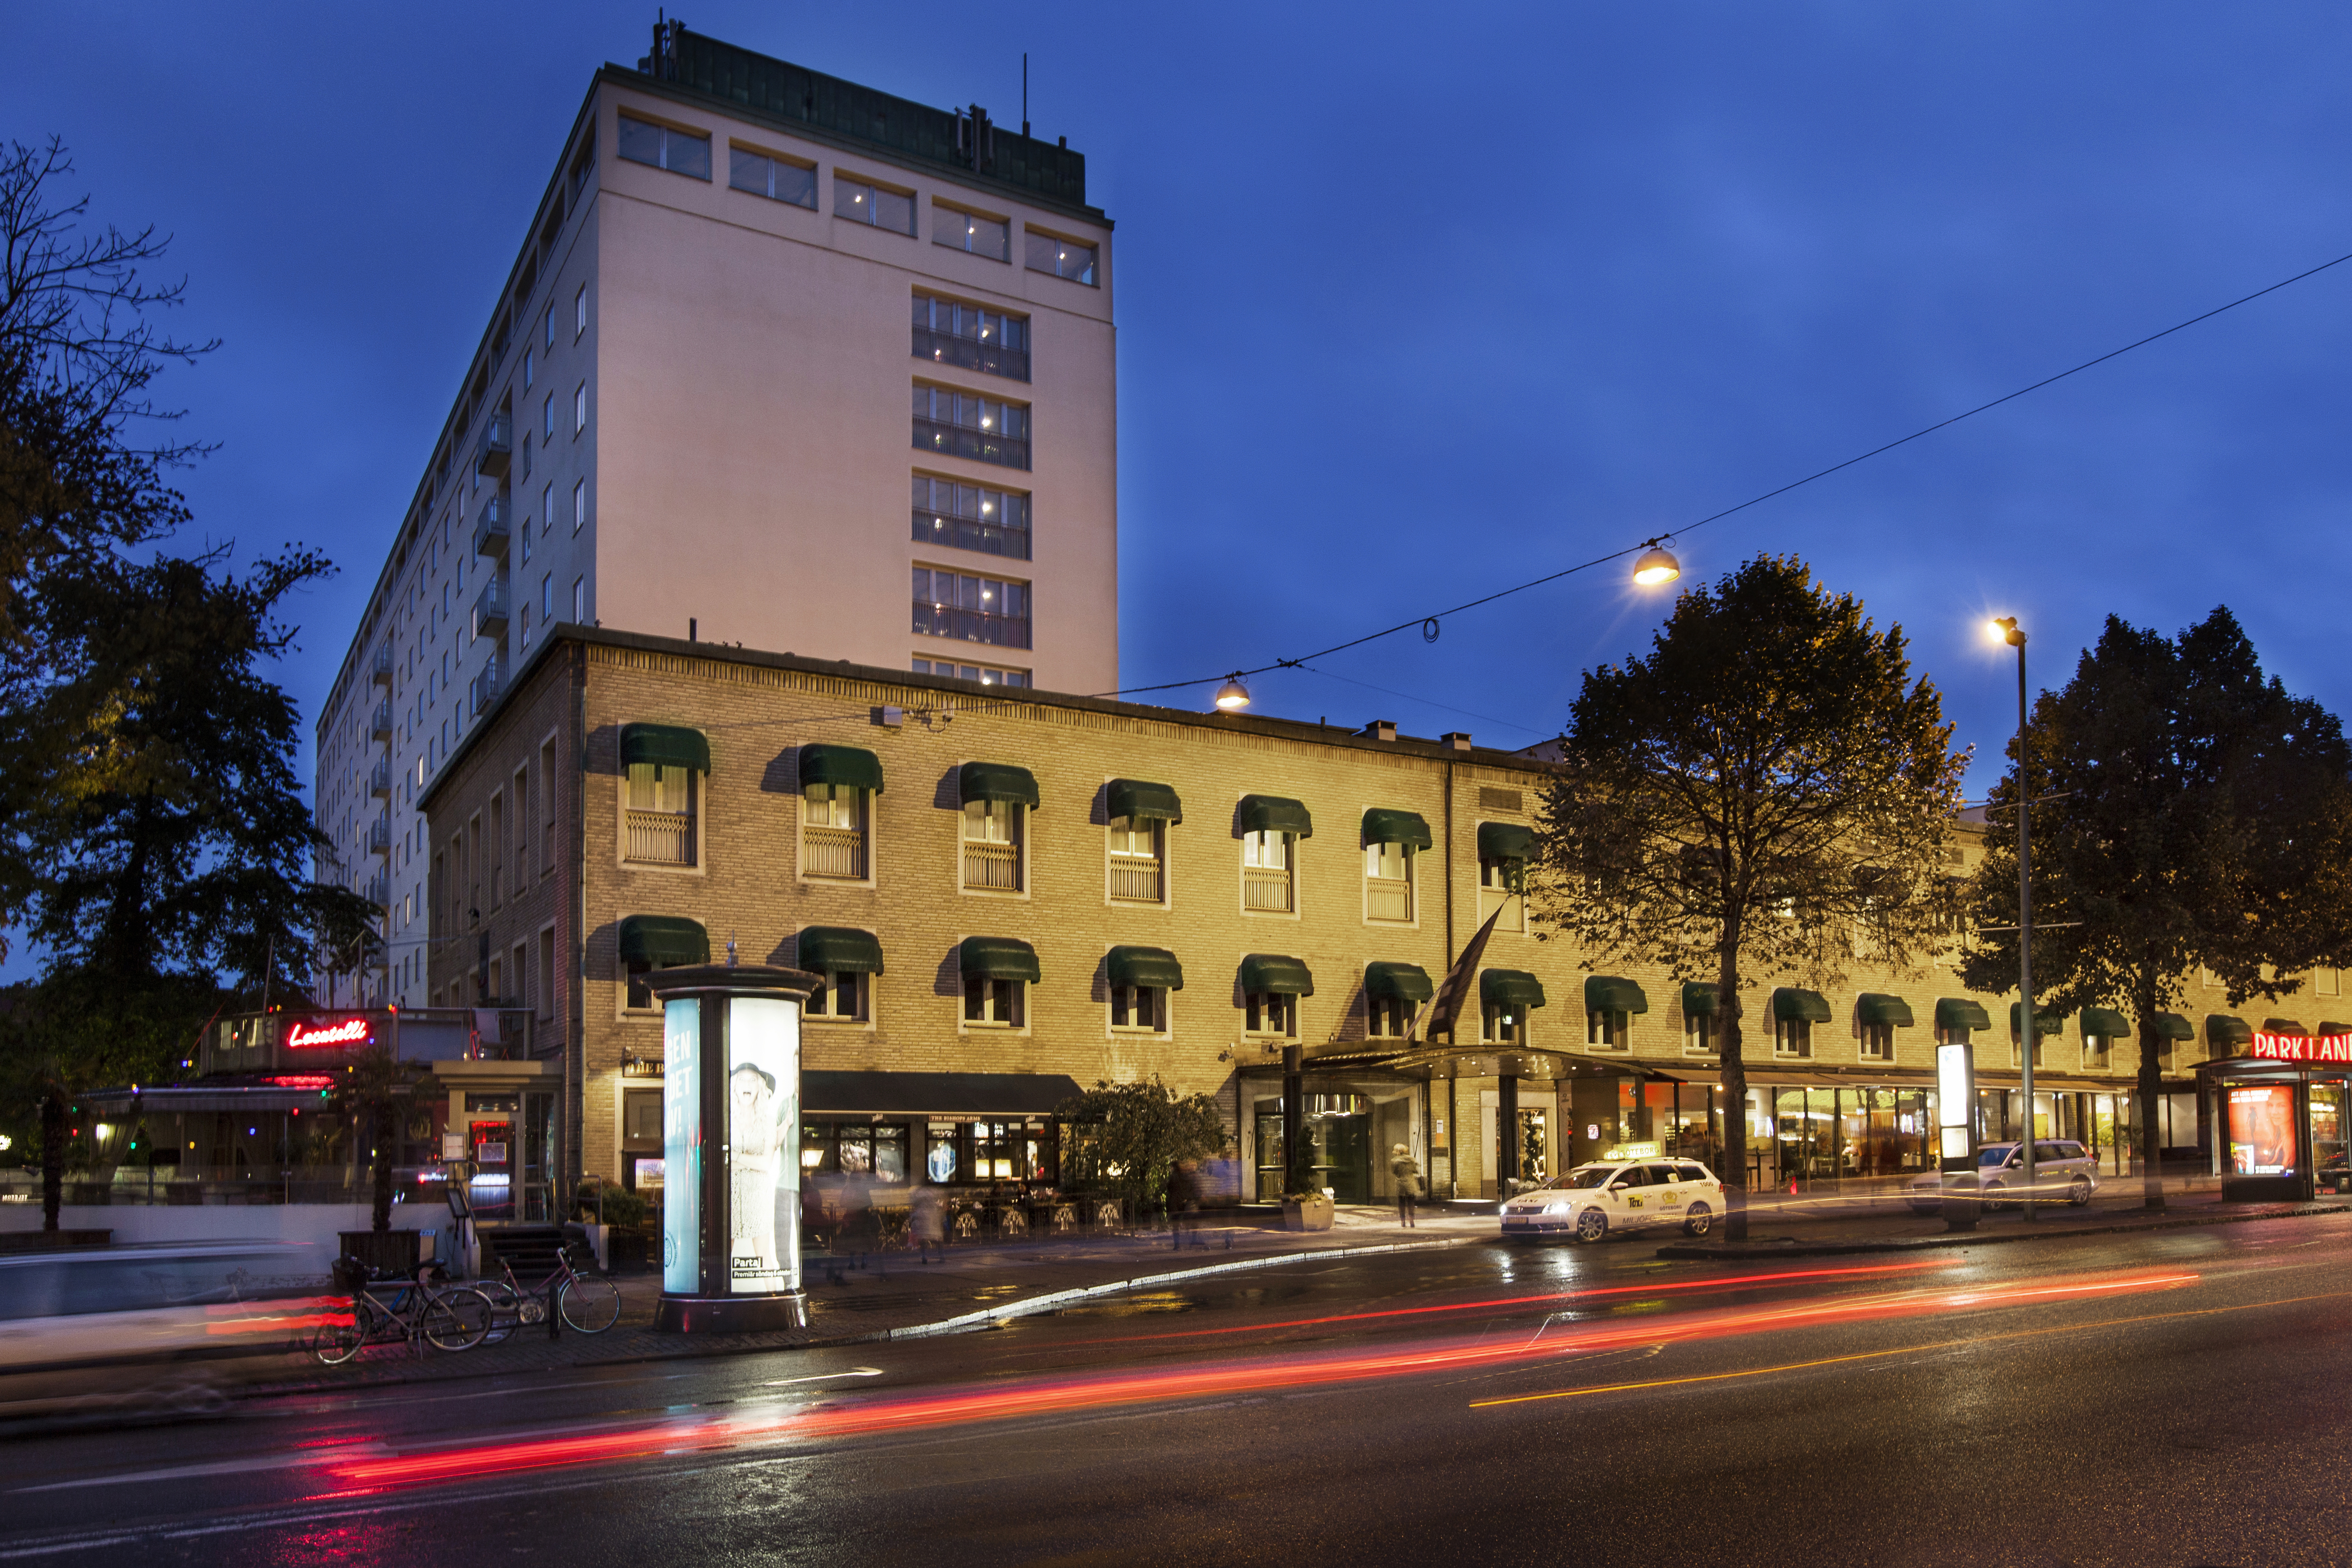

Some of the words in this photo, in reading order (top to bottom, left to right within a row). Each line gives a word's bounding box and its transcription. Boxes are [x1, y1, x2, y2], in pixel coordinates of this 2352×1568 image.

[2255, 1032, 2303, 1059] PARK
[669, 1065, 692, 1102] DET
[1621, 1146, 1659, 1156] GÖTEBORG
[734, 1257, 761, 1268] Partaj
